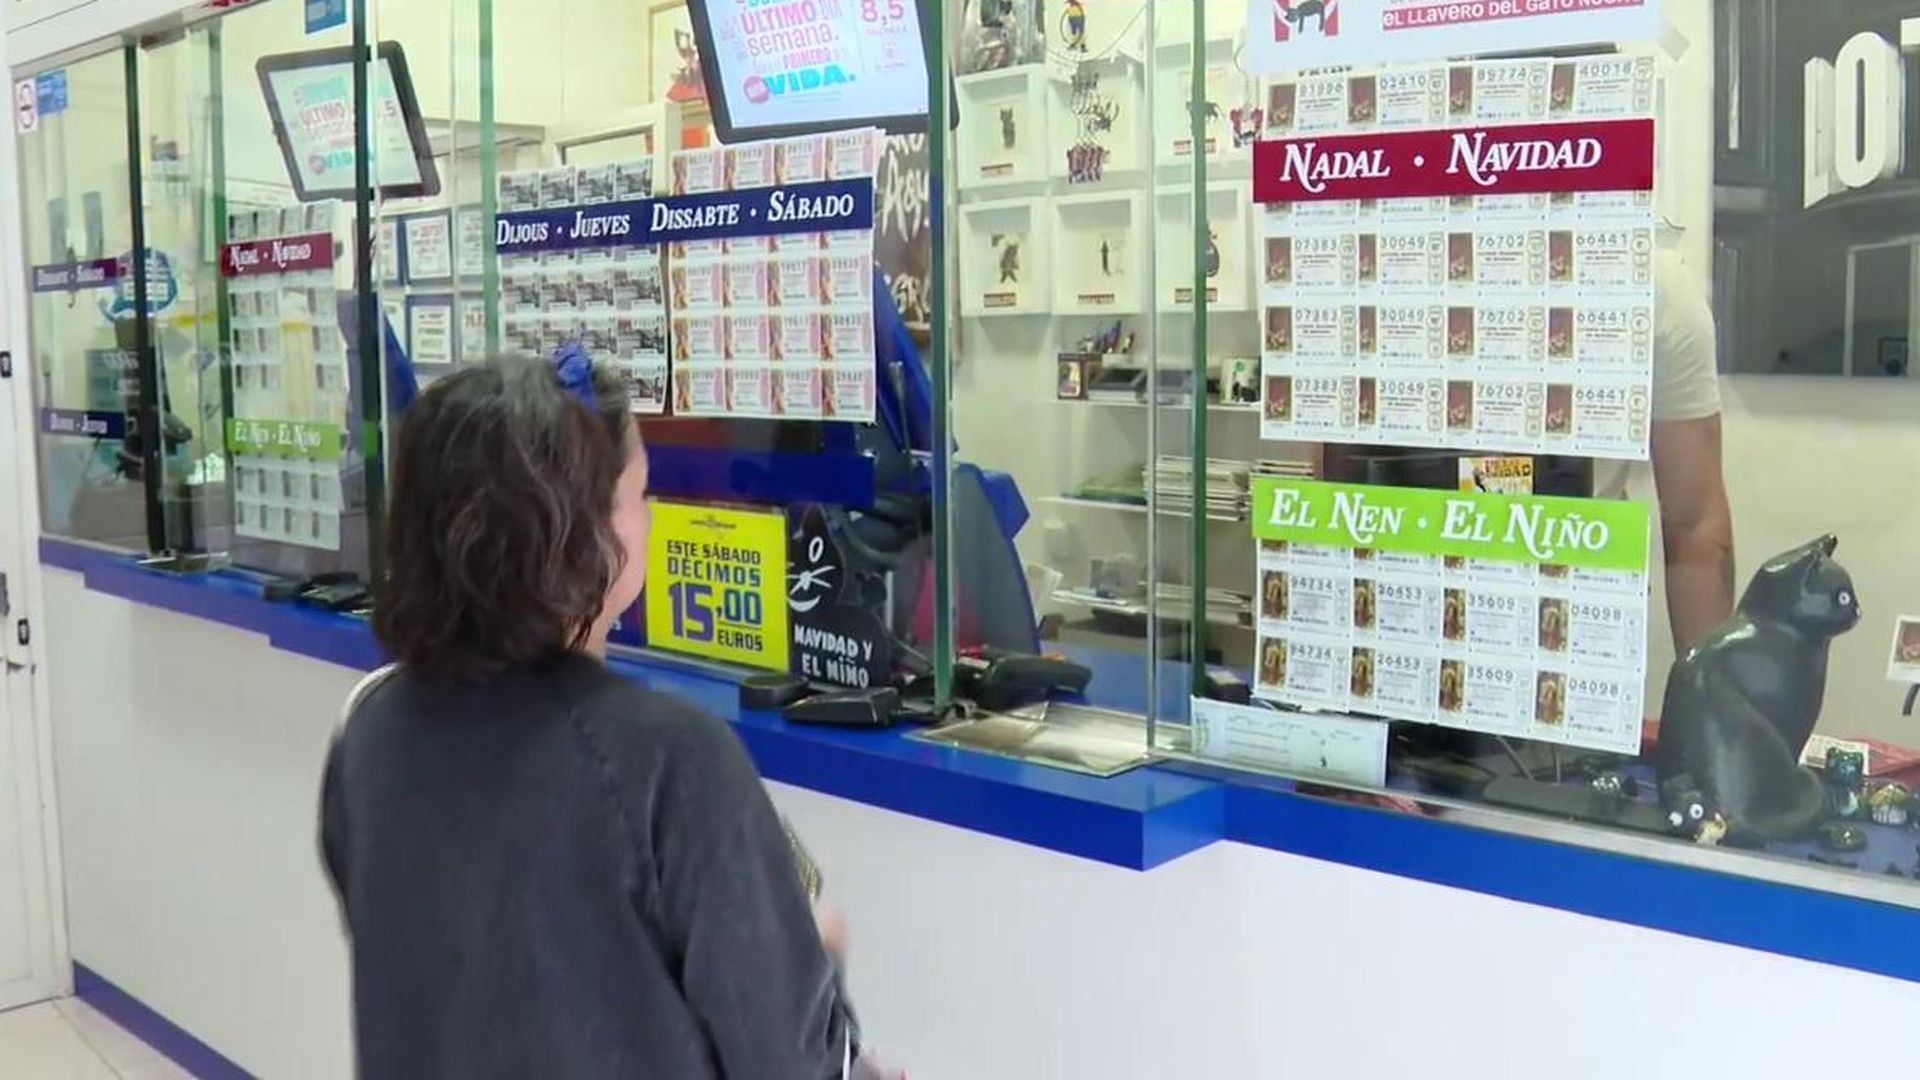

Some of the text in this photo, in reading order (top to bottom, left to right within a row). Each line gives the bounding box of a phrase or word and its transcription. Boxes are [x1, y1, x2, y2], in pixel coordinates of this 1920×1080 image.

[741, 1, 816, 35] ÚLTIMO
[1280, 132, 1601, 193] NADAL NAVIDAD
[496, 219, 549, 246] DIJOUS
[570, 211, 631, 238] JUEVES
[650, 203, 740, 231] DISSABTE
[767, 191, 854, 221] SÁBADO
[1269, 488, 1610, 559] EL NEN EL NIÑO
[667, 540, 761, 565] ESTE SÁBADO
[717, 629, 763, 651] EUROS
[794, 622, 873, 661] NAVIDAD Y
[802, 652, 822, 677] EL
